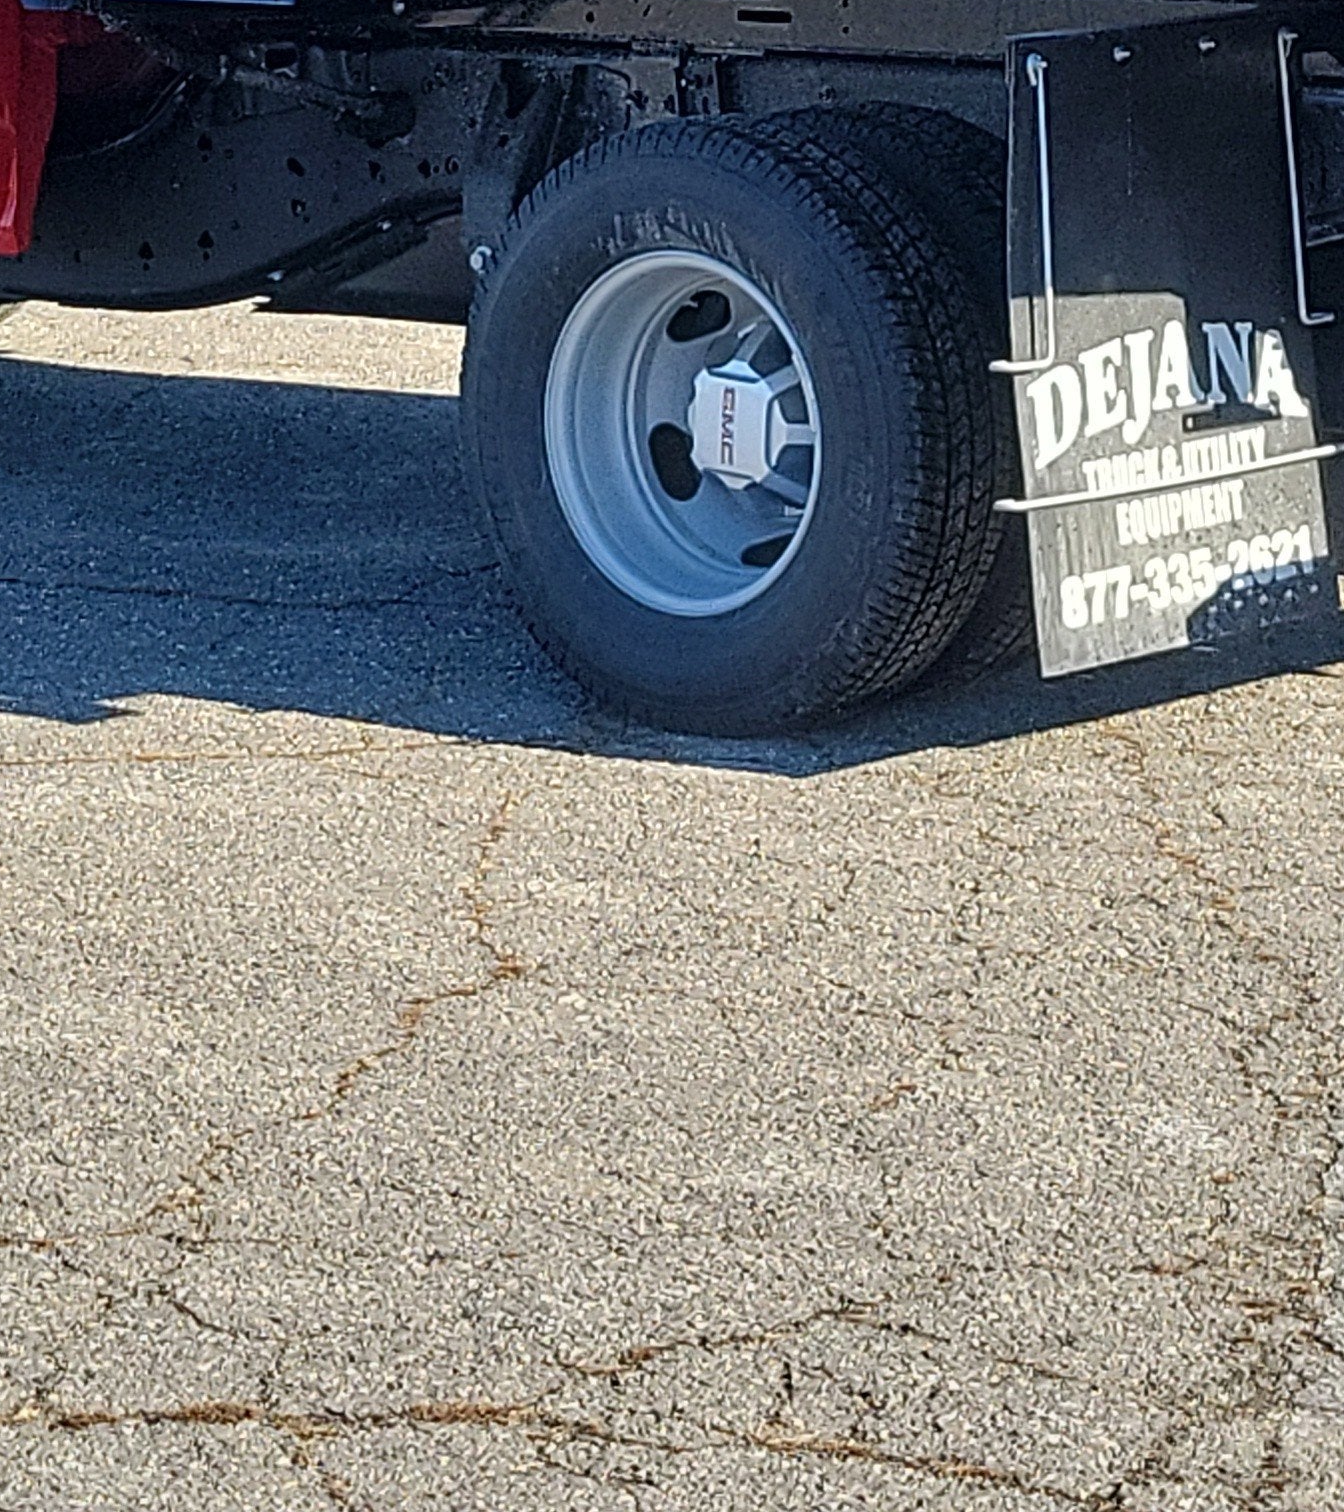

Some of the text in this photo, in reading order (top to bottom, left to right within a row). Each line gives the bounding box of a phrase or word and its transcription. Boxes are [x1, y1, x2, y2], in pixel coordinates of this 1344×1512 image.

[720, 387, 735, 466] GMC
[1026, 319, 1308, 470] DEJANA
[1116, 479, 1244, 546] EQUIPMENT
[1060, 524, 1314, 629] 877-335-2621
